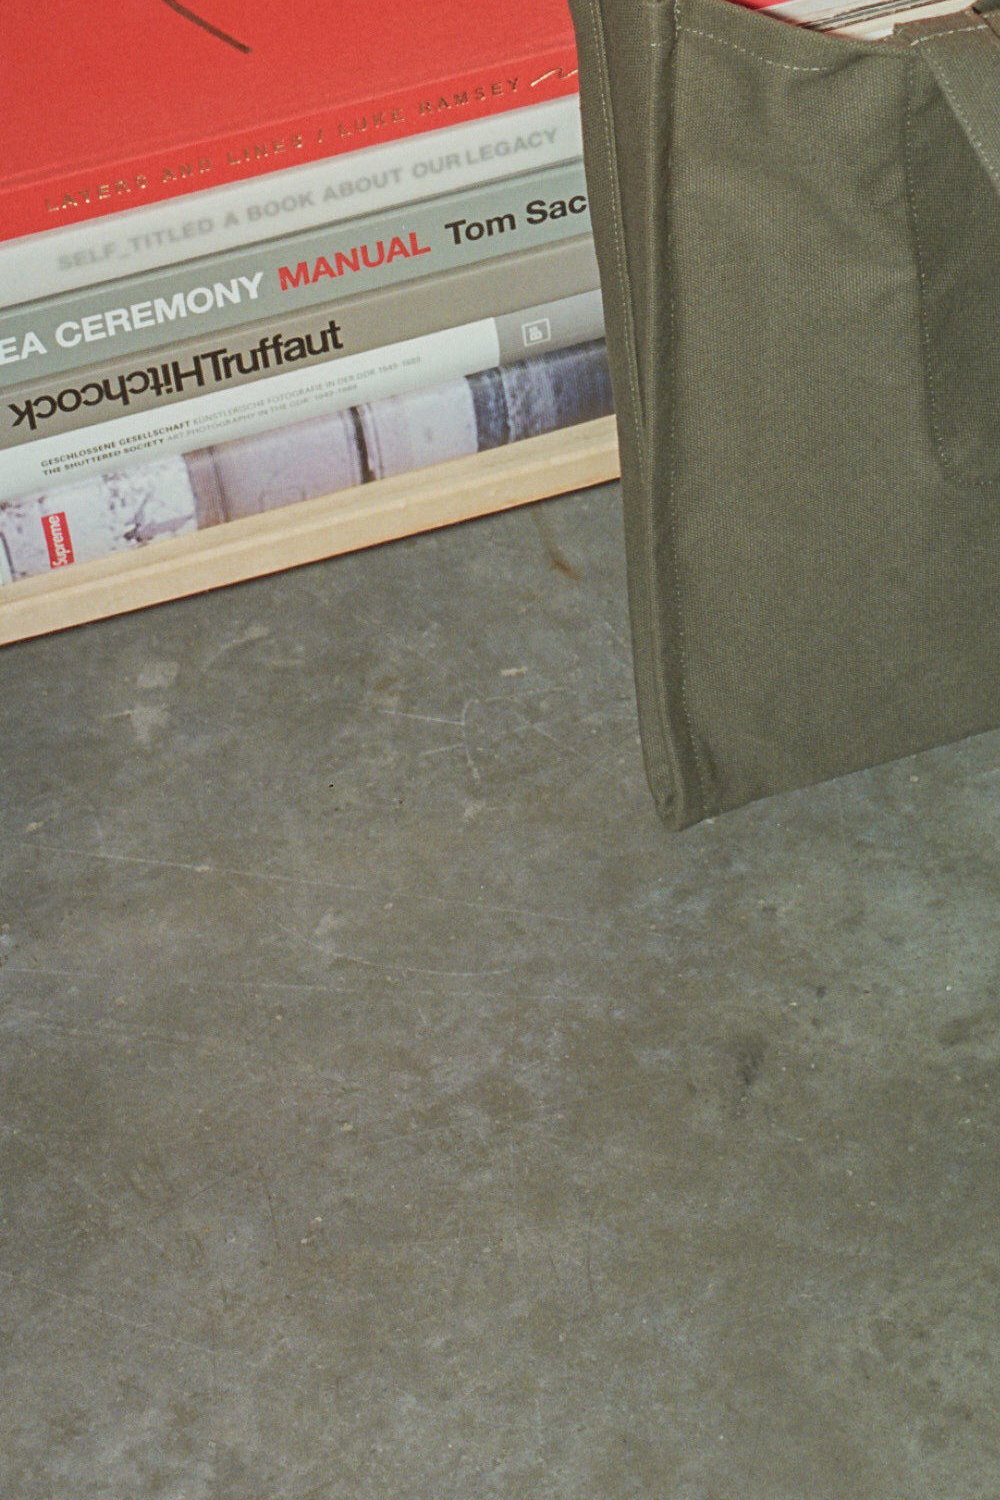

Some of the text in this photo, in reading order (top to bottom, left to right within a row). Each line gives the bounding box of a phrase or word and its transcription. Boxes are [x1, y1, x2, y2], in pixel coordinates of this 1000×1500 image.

[42, 169, 151, 214] LAYERS
[158, 151, 215, 184] AND
[223, 130, 306, 167] LINES
[335, 105, 407, 138] LUKE
[415, 74, 523, 116] RAMSEY
[55, 126, 561, 272] SELF_TITLED A BOOK ABOUT OUR LEGACY
[50, 271, 270, 350] CEREMONY
[274, 228, 433, 292] MANUAL
[441, 206, 518, 248] Tom
[8, 320, 344, 431] Hitchcock Truffaut
[39, 440, 118, 468] GESCHLOSSENE
[117, 419, 192, 447] GESELLSCHAFT
[265, 382, 325, 405] FOTOGRAFIE
[335, 373, 355, 386] DER
[355, 367, 377, 381] DDR
[42, 465, 63, 477] THE
[63, 448, 123, 472] SHUTTERED
[122, 436, 165, 455] SOCIETY
[183, 410, 257, 437] PHOTOGRAPHY
[48, 515, 72, 566] Supreme
